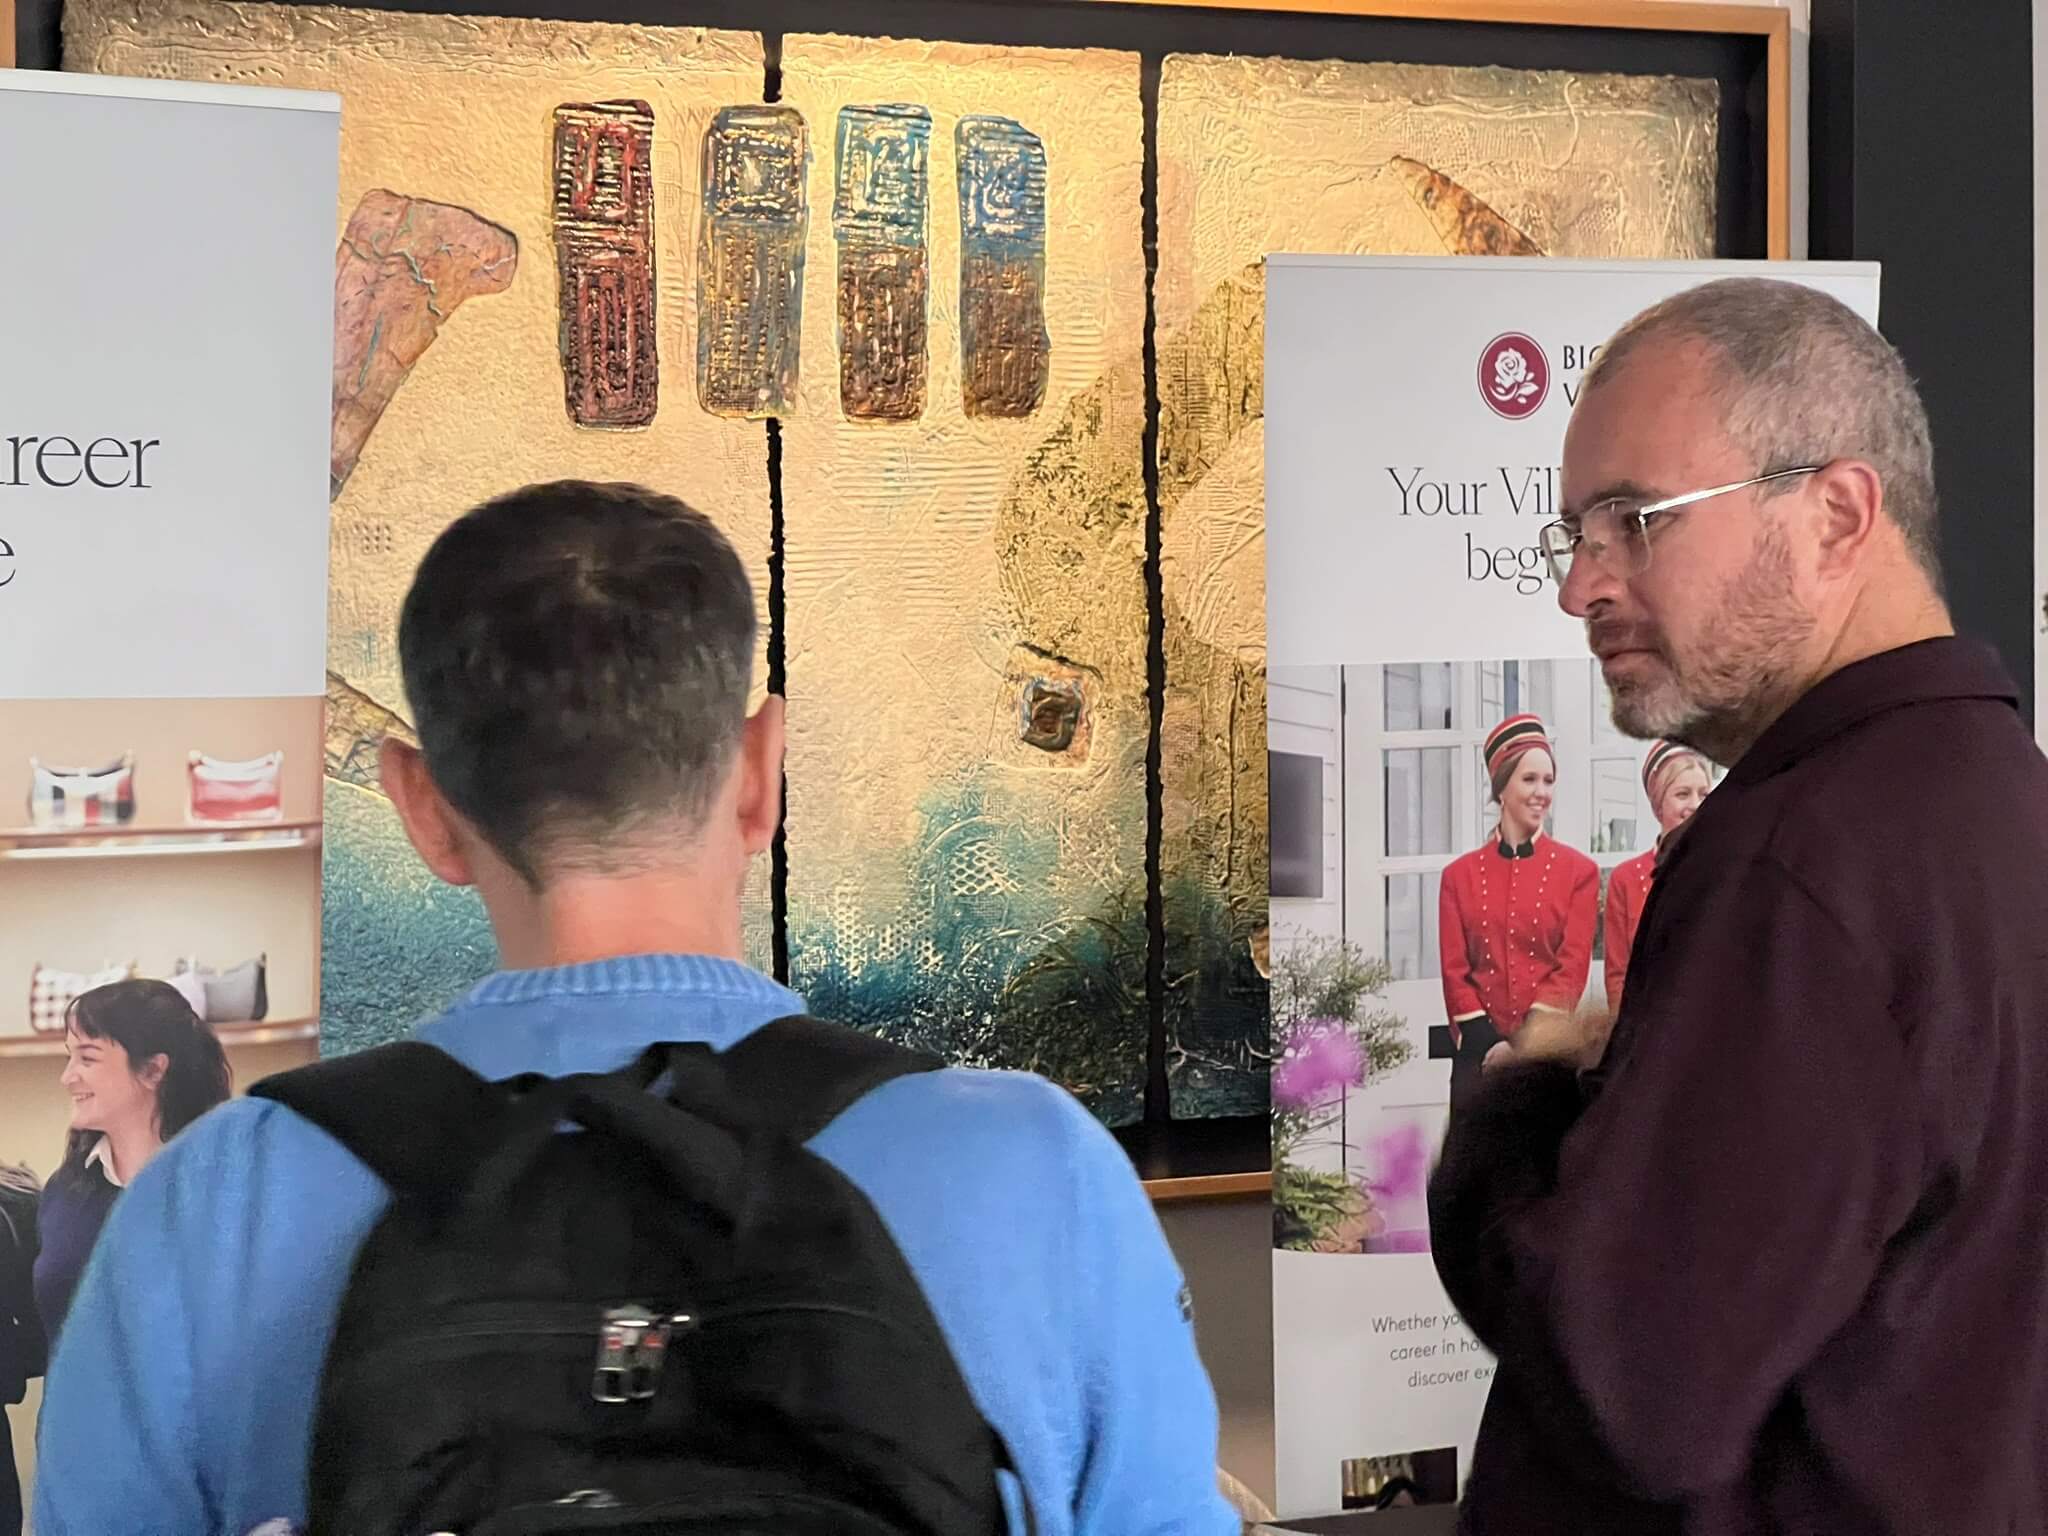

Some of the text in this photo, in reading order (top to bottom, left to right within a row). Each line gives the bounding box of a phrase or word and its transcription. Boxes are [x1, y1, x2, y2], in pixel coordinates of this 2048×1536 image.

[0, 435, 160, 489] reer
[1385, 467, 1487, 516] Your
[1371, 1314, 1438, 1333] Whether
[1390, 1344, 1438, 1361] career
[1442, 1339, 1456, 1355] in
[1407, 1368, 1470, 1388] discover
